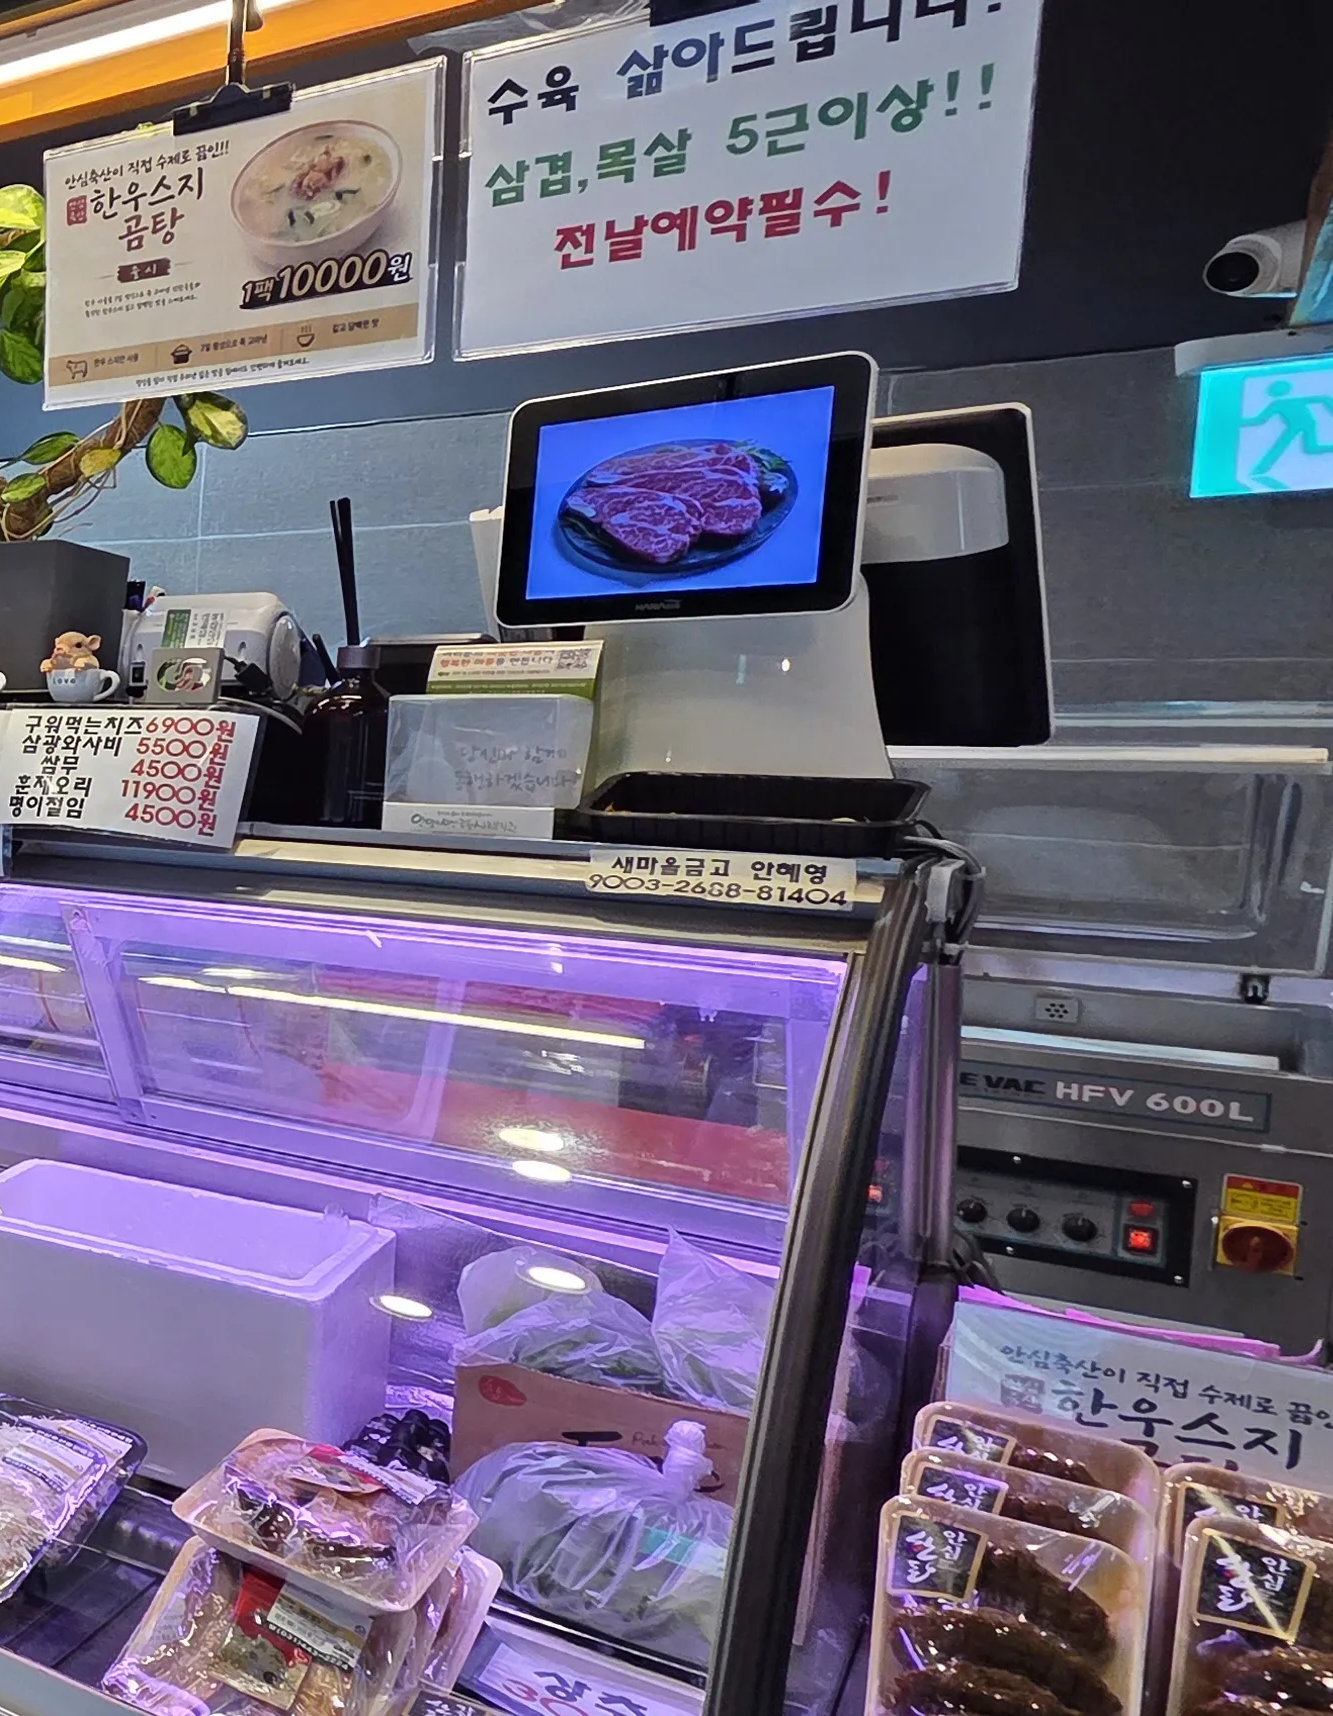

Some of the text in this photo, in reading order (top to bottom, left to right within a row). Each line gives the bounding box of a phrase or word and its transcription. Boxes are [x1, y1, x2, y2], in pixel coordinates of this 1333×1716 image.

[487, 0, 1002, 125] 수육 삶아드립니
[484, 63, 996, 208] 삼겹,목살 5근이상!!
[65, 165, 123, 190] 안심축산이
[128, 157, 152, 174] 직접
[156, 150, 192, 170] 수제로
[90, 167, 204, 220] 한우스지
[118, 207, 185, 252] 곰탕
[553, 170, 891, 271] 전날예약필수!
[241, 276, 275, 305] 1팩
[278, 250, 414, 299] 10000원
[22, 735, 229, 765] 삼광와사비 5500원
[40, 755, 225, 790] 쌈무 4500원
[8, 796, 218, 837] 명이절임 4500원
[120, 778, 218, 811] 11900원
[610, 854, 828, 886] 새마을금고 안혜영
[1055, 1080, 1135, 1107] HFV
[1145, 1092, 1254, 1123] 600L
[1000, 1345, 1126, 1384] 안심축산이
[1136, 1371, 1189, 1399] 직접
[1197, 1384, 1278, 1417] 수제로
[1051, 1379, 1303, 1470] 한우스지
